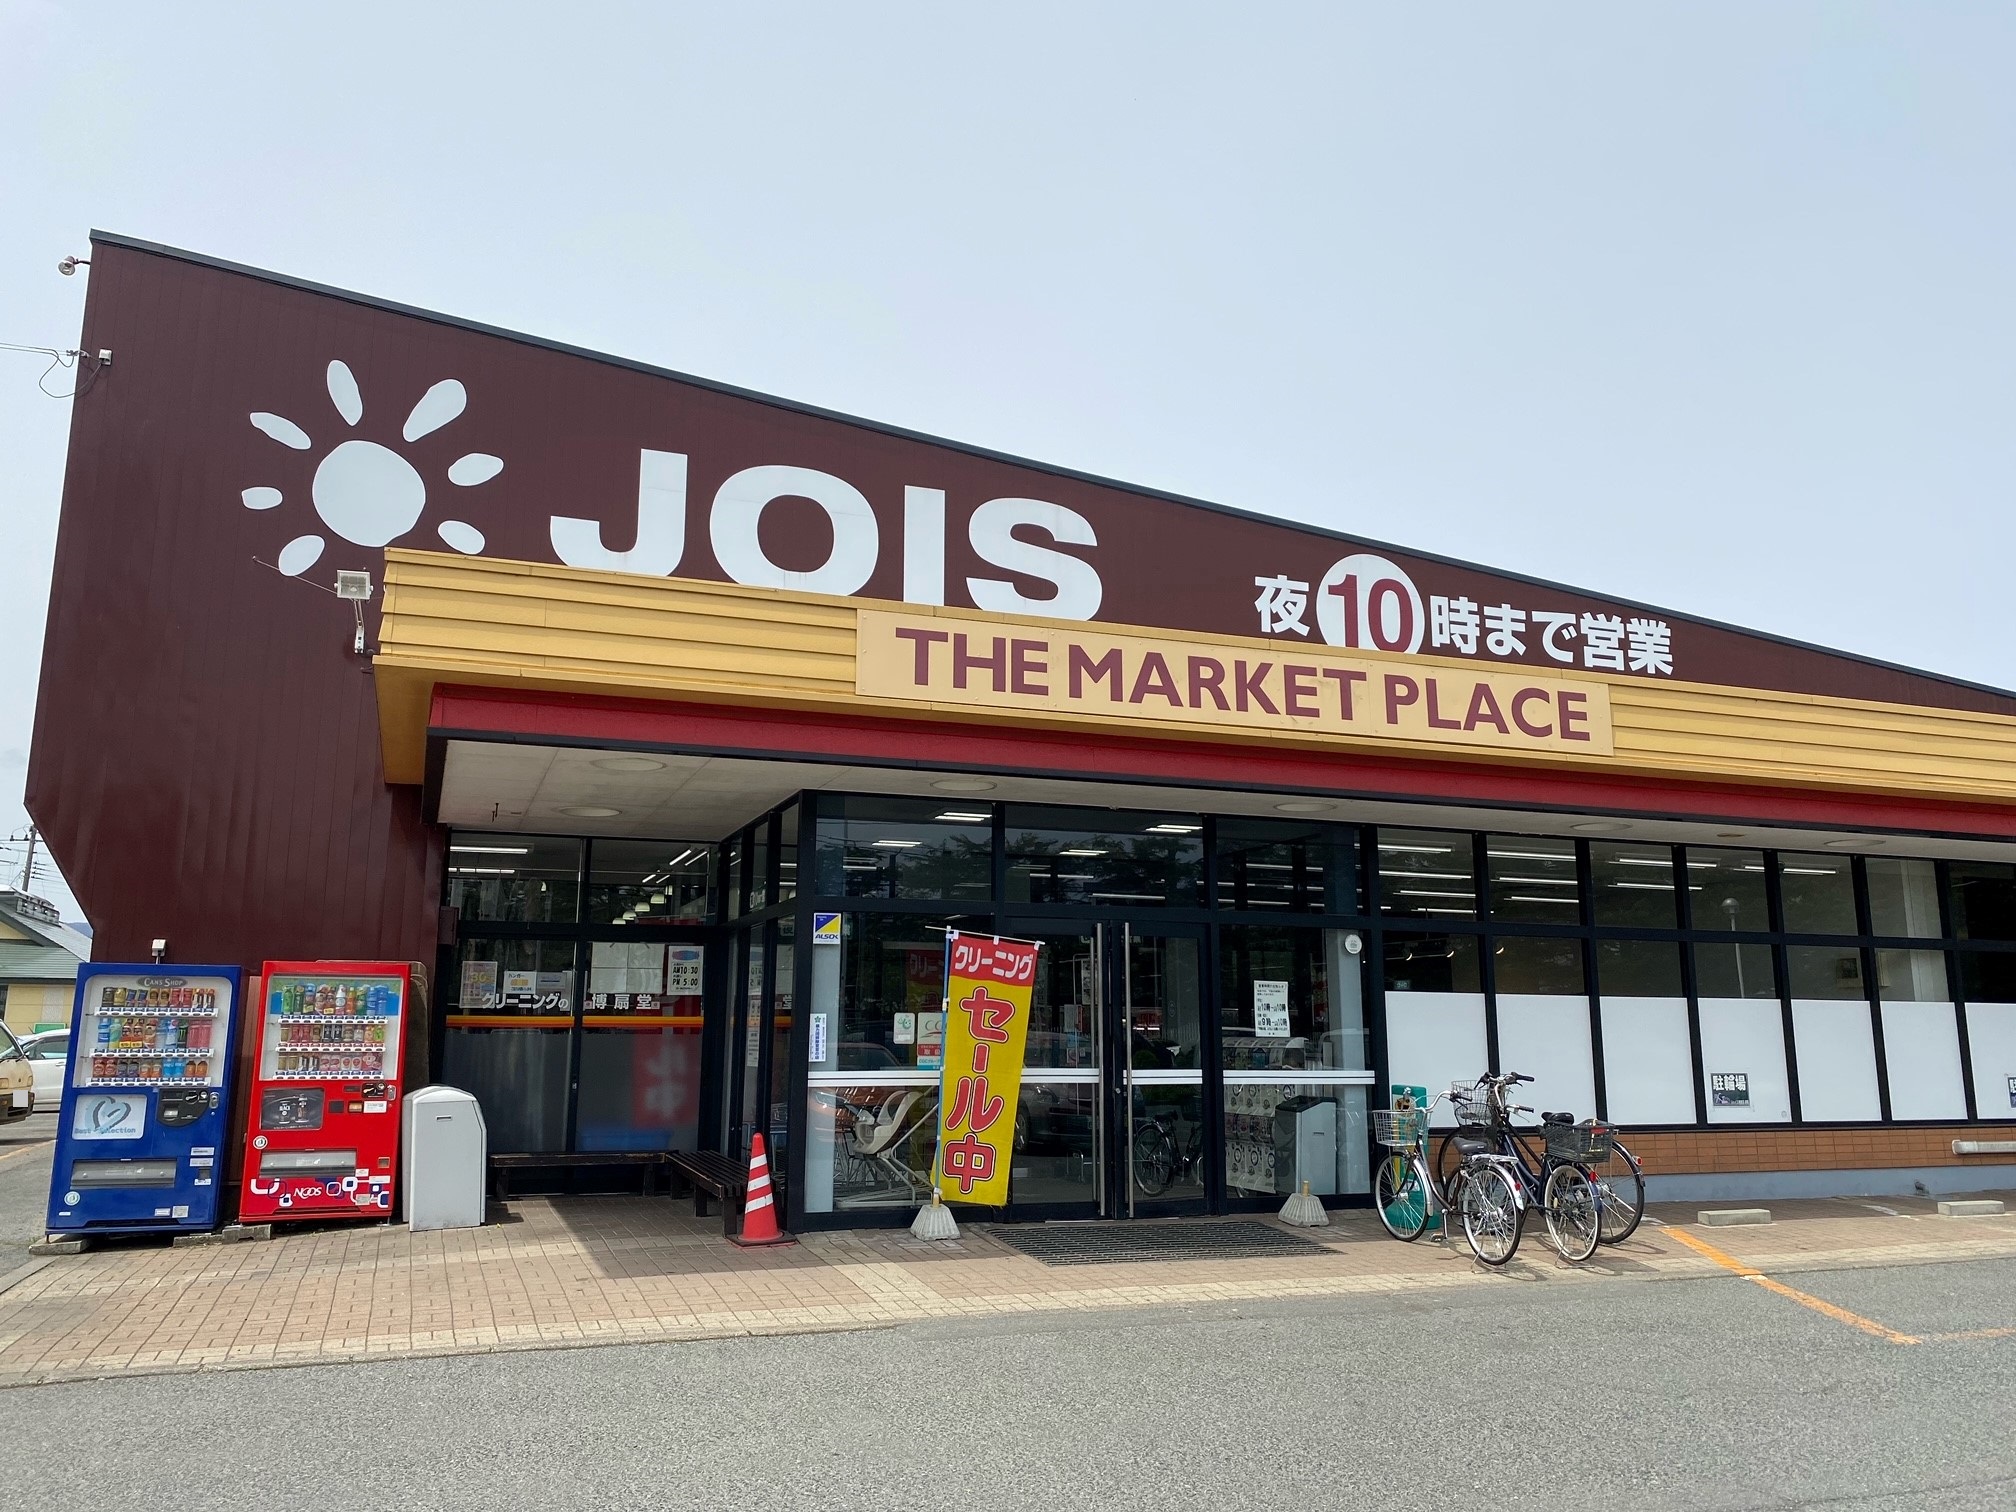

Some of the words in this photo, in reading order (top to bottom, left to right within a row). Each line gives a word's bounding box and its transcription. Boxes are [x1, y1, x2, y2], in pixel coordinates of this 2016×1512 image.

[550, 448, 1103, 621] JOIS
[1254, 574, 1674, 676] 夜10時まで営業
[895, 626, 1049, 696] THE
[1068, 644, 1367, 721] MARKET
[1384, 673, 1591, 742] PLACE
[482, 993, 568, 1009] クリーニングの
[955, 945, 1034, 980] クリーニング
[942, 986, 1016, 1194] セール中
[1713, 1075, 1746, 1091] 駐輪場
